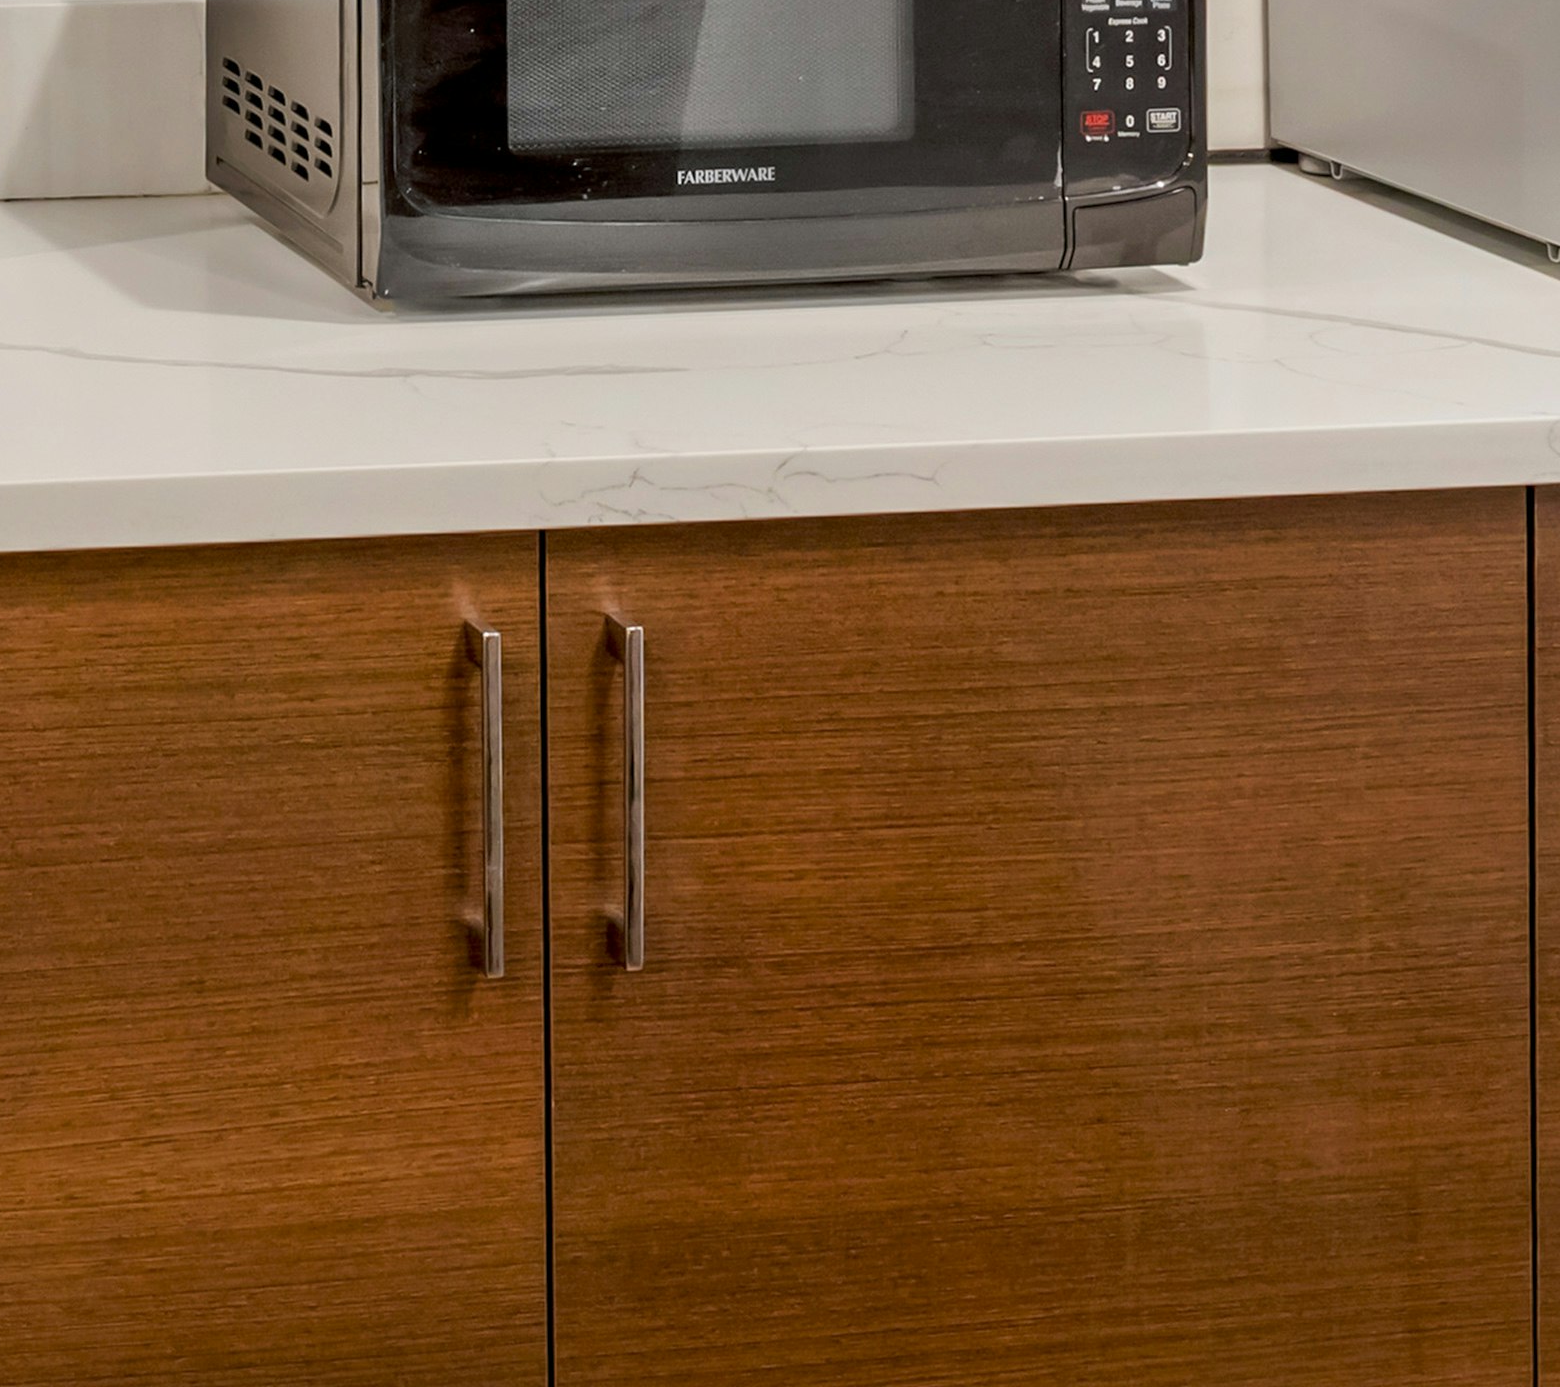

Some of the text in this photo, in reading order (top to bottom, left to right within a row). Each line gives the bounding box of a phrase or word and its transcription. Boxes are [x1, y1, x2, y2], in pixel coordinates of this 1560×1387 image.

[1092, 30, 1100, 44] 1
[1125, 30, 1134, 42] 2
[1157, 29, 1166, 42] 3
[1092, 56, 1101, 68] 4
[1125, 55, 1134, 67] 5
[1157, 54, 1166, 67] 6
[1092, 78, 1101, 91] 7
[1125, 77, 1134, 90] 8
[1157, 76, 1166, 89] 9
[1085, 114, 1109, 124] STOP
[1125, 115, 1135, 128] 0
[1149, 112, 1178, 122] START
[677, 166, 776, 185] FARBERWARE
